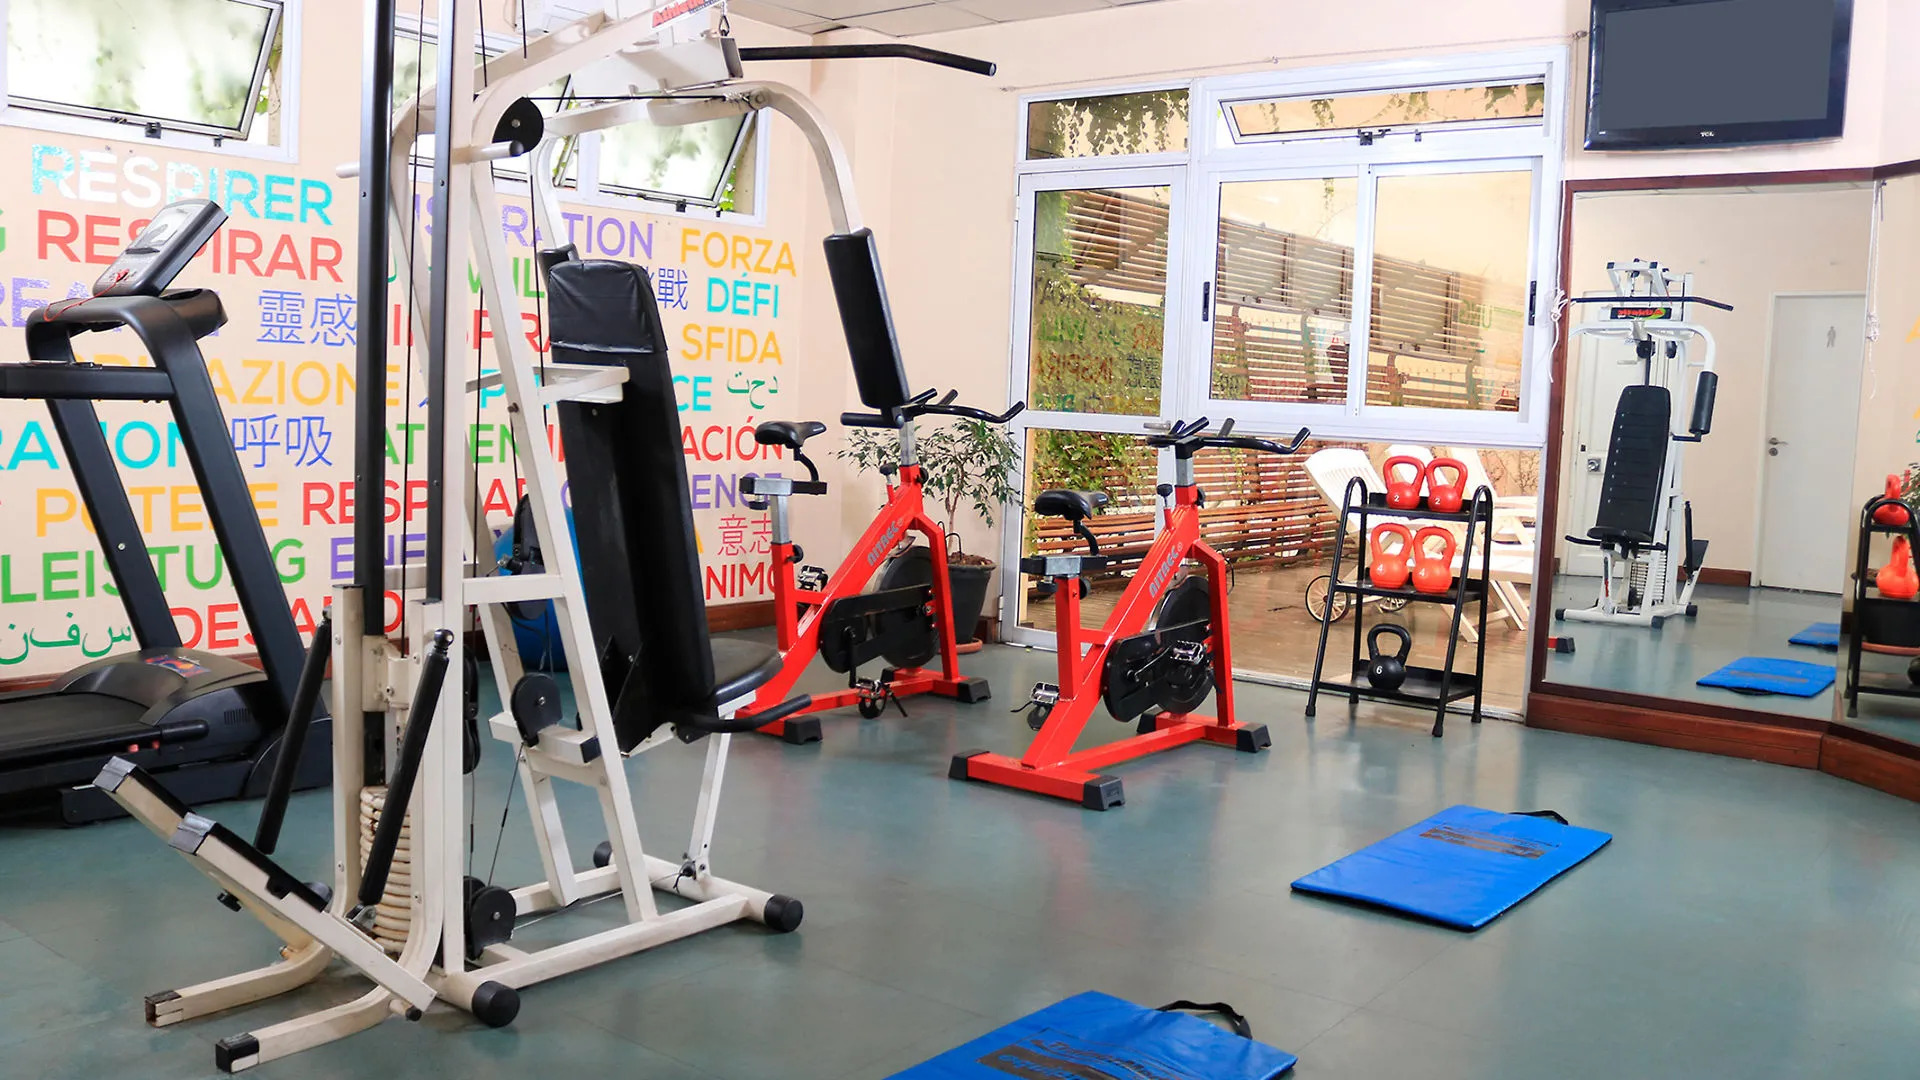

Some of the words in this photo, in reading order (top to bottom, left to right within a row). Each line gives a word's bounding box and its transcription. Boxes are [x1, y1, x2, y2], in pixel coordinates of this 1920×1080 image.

[32, 144, 333, 226] RESPIRER
[37, 209, 343, 284] REIRAR
[680, 227, 797, 277] FORZA
[645, 266, 689, 310] 戰
[706, 272, 779, 318] DÉFI
[256, 290, 357, 346] 靈感
[681, 323, 783, 365] SFIDA
[231, 414, 333, 468] 呼吸
[36, 483, 278, 538] PTEE
[1394, 494, 1400, 502] 2
[717, 513, 772, 556] 意志
[1, 538, 306, 604] LEITUG
[1376, 665, 1383, 675] 6
